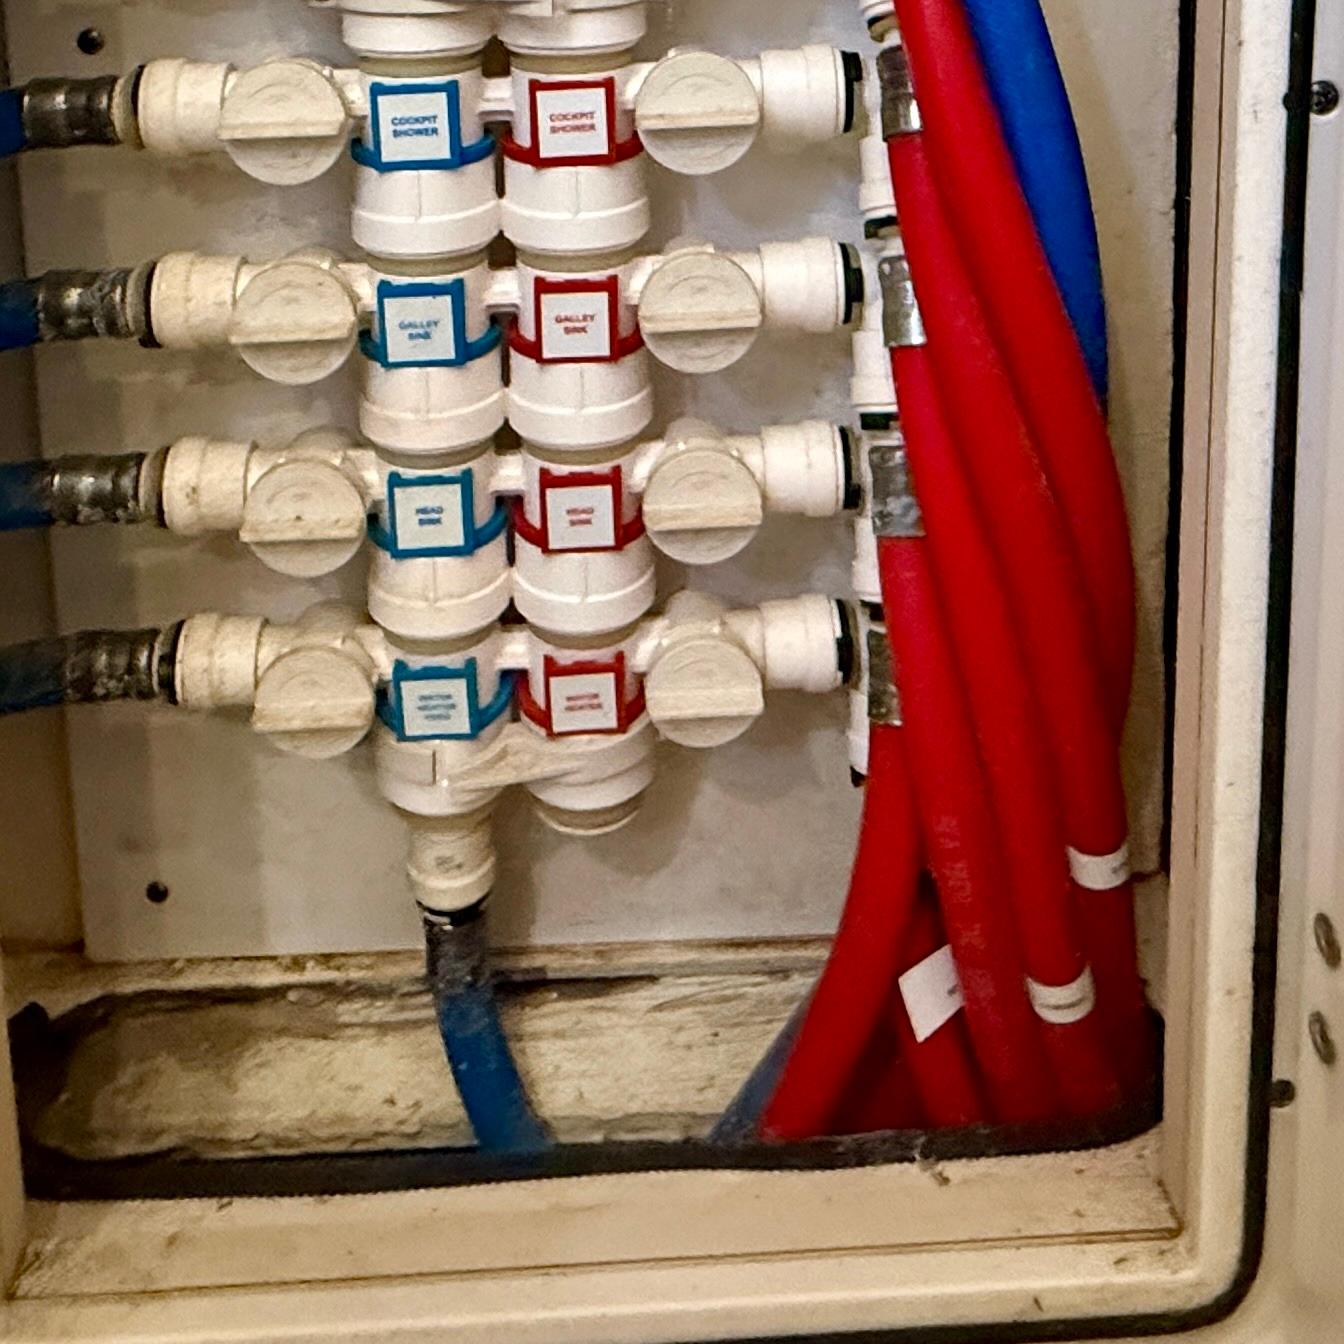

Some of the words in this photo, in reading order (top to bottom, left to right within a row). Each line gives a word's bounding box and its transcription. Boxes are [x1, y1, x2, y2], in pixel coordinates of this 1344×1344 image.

[391, 115, 437, 125] COCKPIT
[549, 112, 595, 122] COCKPIT
[392, 127, 439, 137] SHOWER
[549, 123, 596, 133] SHOWER
[555, 314, 595, 323] GALLEY
